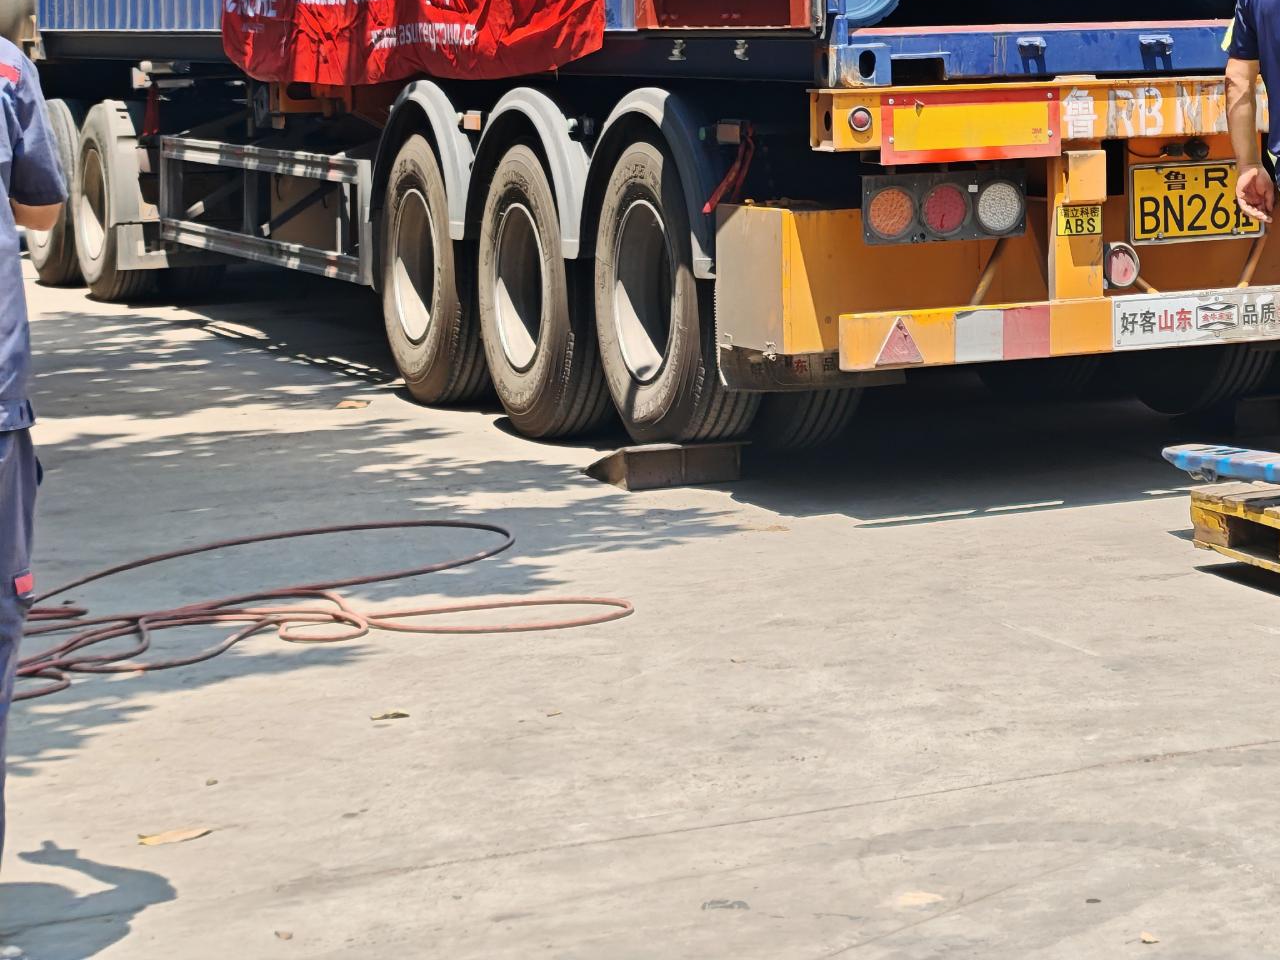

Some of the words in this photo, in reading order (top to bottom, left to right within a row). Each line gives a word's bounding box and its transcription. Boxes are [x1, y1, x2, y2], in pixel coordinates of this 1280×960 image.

[1063, 217, 1096, 234] ABS
[1120, 307, 1193, 336] 好客山东
